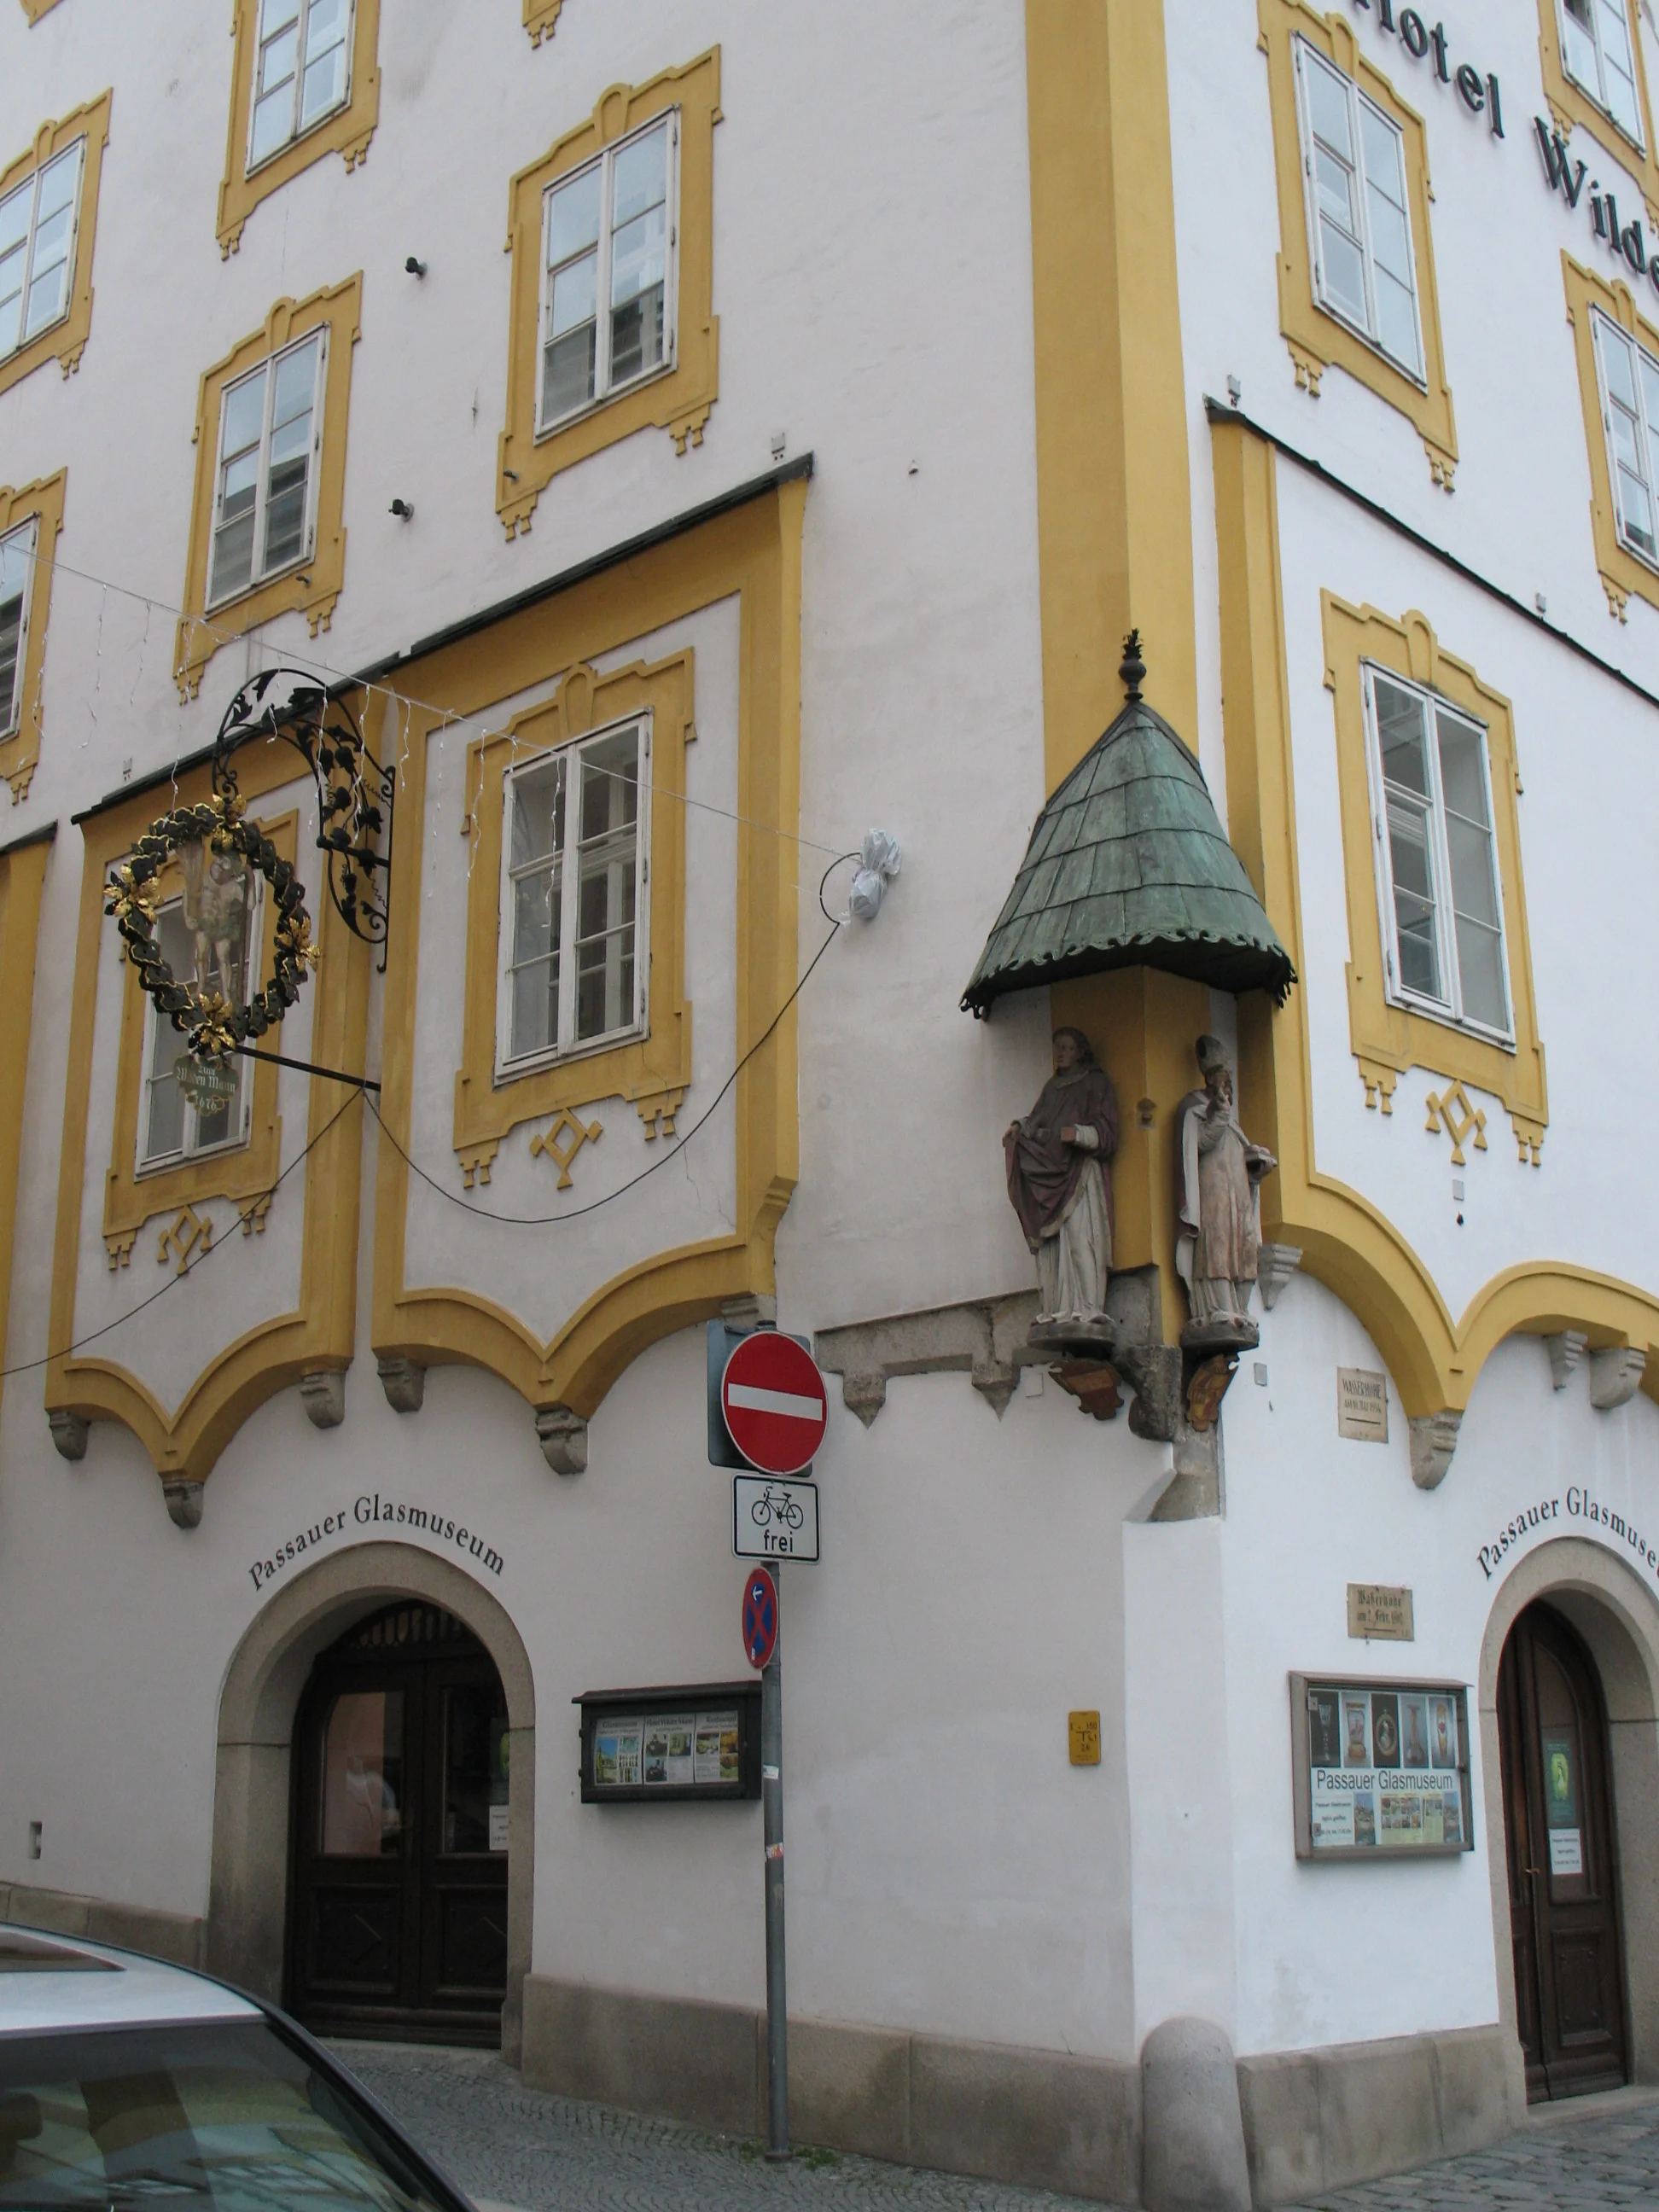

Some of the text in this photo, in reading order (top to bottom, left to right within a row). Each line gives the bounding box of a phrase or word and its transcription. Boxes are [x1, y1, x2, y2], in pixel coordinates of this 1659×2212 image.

[209, 1075, 236, 1092] Mann
[248, 1493, 504, 1591] Passauer Glasmuseum
[763, 1531, 794, 1553] frei
[1476, 1486, 1659, 1581] Passauer Glasmuse
[1316, 1769, 1453, 1790] Passauer Glasmuseum
